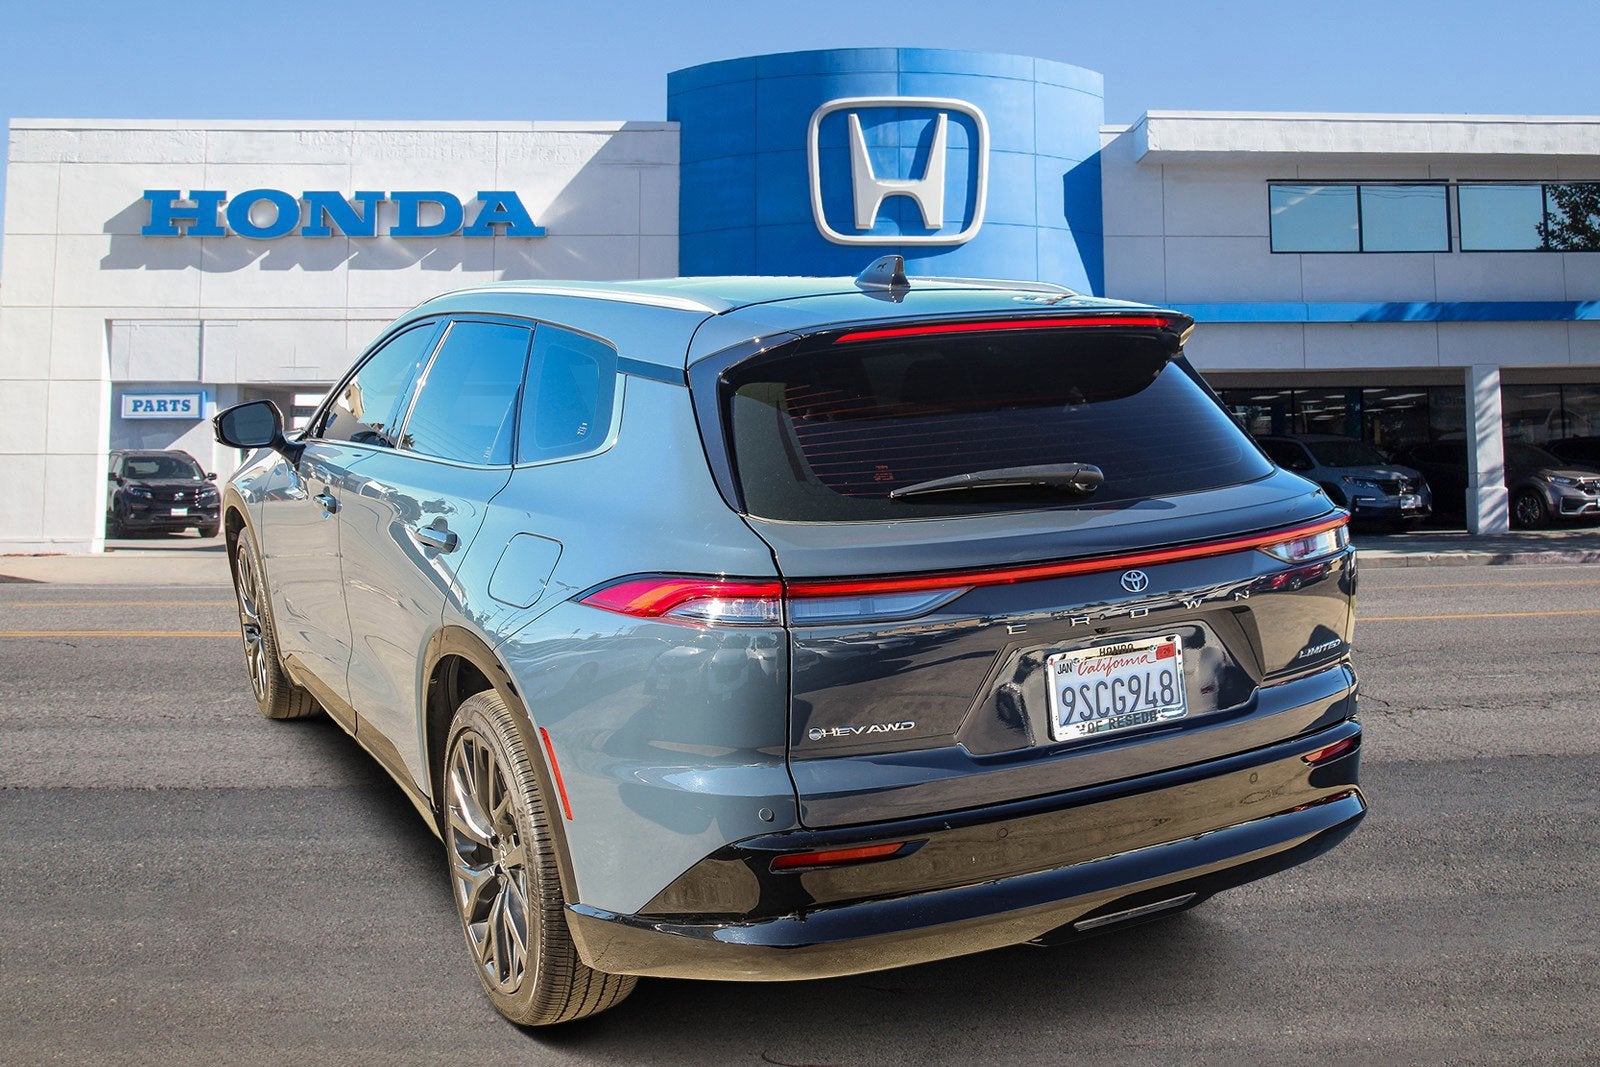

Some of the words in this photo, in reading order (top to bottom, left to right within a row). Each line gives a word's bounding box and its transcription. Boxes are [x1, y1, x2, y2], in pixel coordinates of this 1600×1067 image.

[141, 189, 548, 240] HONDA
[131, 399, 192, 412] PARTS
[1007, 590, 1250, 635] CROWN
[1298, 638, 1342, 659] LIMITED
[1057, 660, 1073, 675] JAN
[1077, 654, 1157, 677] California
[1061, 669, 1174, 725] 9SCG948
[1087, 720, 1103, 734] OF
[1108, 709, 1159, 730] RESEDA
